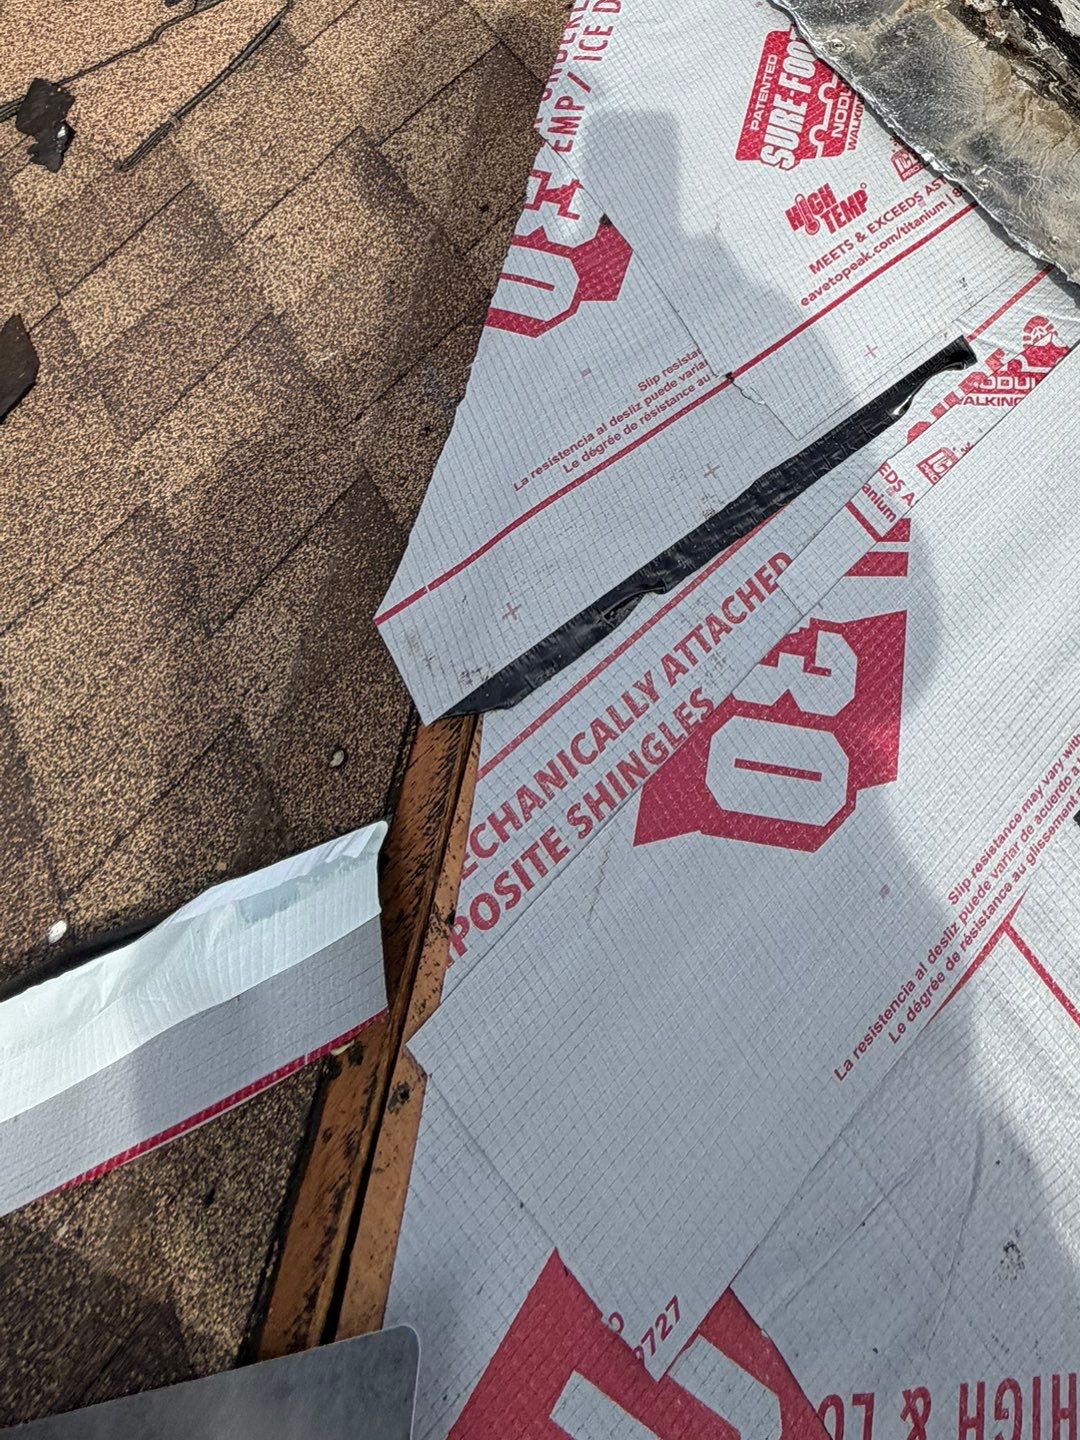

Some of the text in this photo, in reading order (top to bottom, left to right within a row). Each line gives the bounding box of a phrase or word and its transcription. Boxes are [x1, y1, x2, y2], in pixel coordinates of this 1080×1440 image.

[573, 24, 614, 62] ICE
[750, 54, 777, 131] PATENTED
[799, 199, 948, 308] eavetopeak.com/titanium
[808, 238, 855, 275] MEETS
[855, 231, 868, 244] &
[866, 192, 925, 235] EXCEEDS
[513, 477, 529, 492] La
[529, 432, 596, 480] resistencia
[595, 422, 609, 437] al
[609, 401, 644, 428] desliz
[643, 380, 679, 411] puede
[561, 373, 712, 475] Le dégrée de résistance au
[638, 374, 661, 392] Slip
[661, 551, 793, 688] ATTACHED
[565, 686, 715, 841] SHINGLES
[948, 876, 971, 906] Slip
[969, 811, 1023, 880] resistance
[1020, 783, 1044, 814] may
[1041, 758, 1065, 786] vary
[833, 1057, 855, 1082] La
[852, 978, 917, 1061] resistencia
[914, 962, 929, 981] al
[926, 922, 962, 966] desliz
[957, 880, 994, 927] puede
[989, 843, 1022, 881] variar
[1019, 825, 1036, 844] de
[1033, 774, 1073, 826] acuerdo
[1070, 766, 1080, 778] a
[887, 1022, 908, 1045] Le
[905, 971, 947, 1024] dégrée
[944, 951, 963, 974] de
[959, 881, 1015, 954] résistance
[1010, 861, 1029, 883] au
[1025, 794, 1079, 867] glissement
